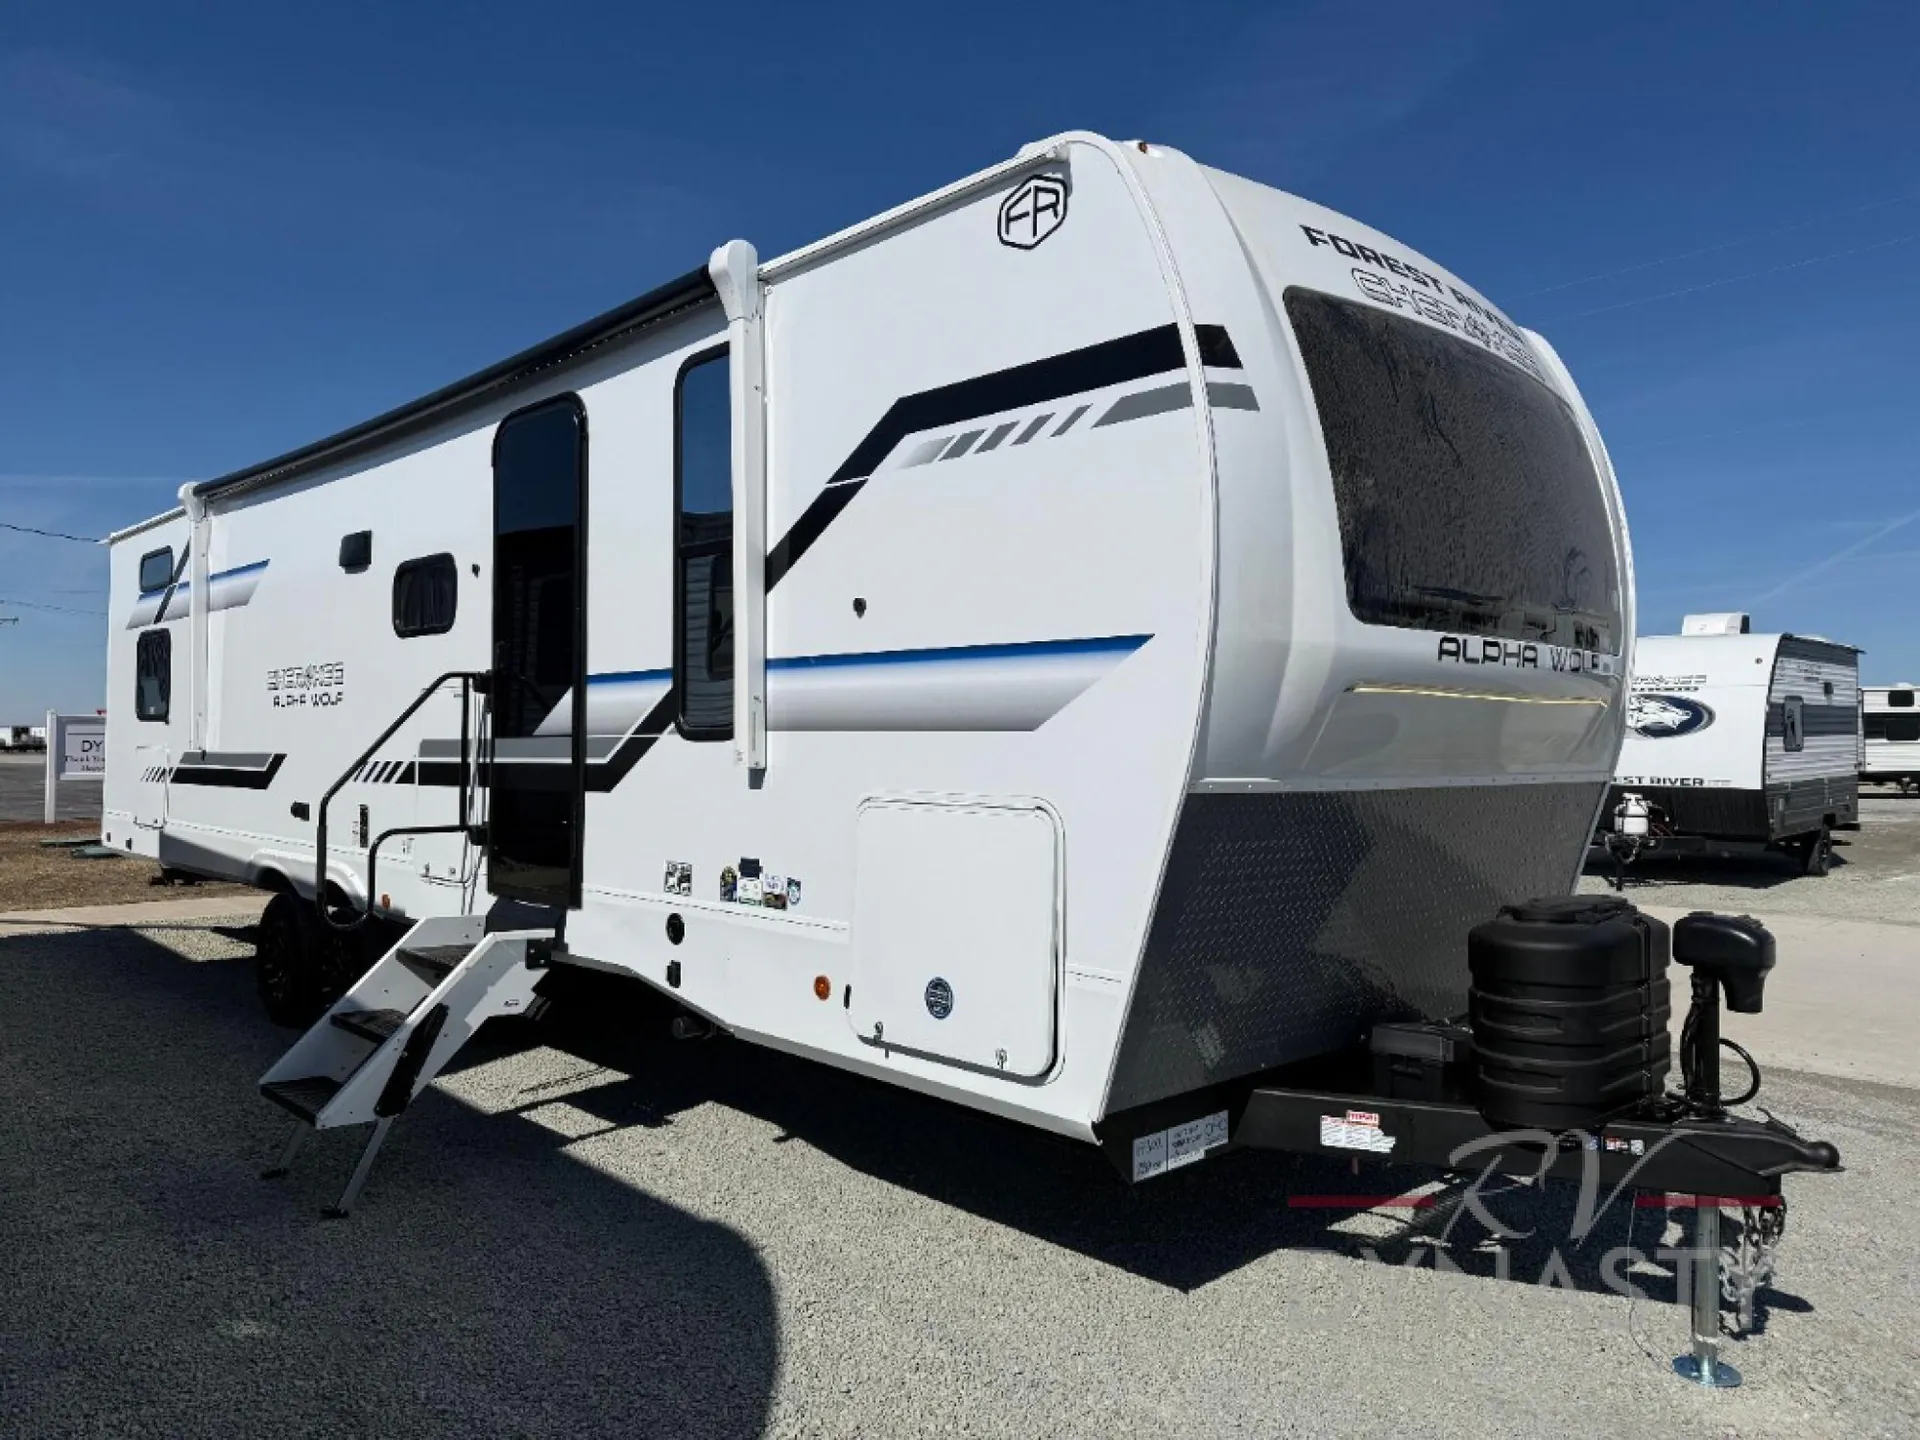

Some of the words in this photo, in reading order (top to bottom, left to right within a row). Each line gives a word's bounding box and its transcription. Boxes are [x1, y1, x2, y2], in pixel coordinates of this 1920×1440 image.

[1300, 225, 1445, 295] FOREST
[1438, 635, 1539, 669] ALPHA
[273, 693, 307, 708] ALPHA
[310, 691, 344, 708] WOLF
[81, 739, 105, 753] DY
[1613, 775, 1645, 785] EST
[1649, 776, 1705, 787] RIVER
